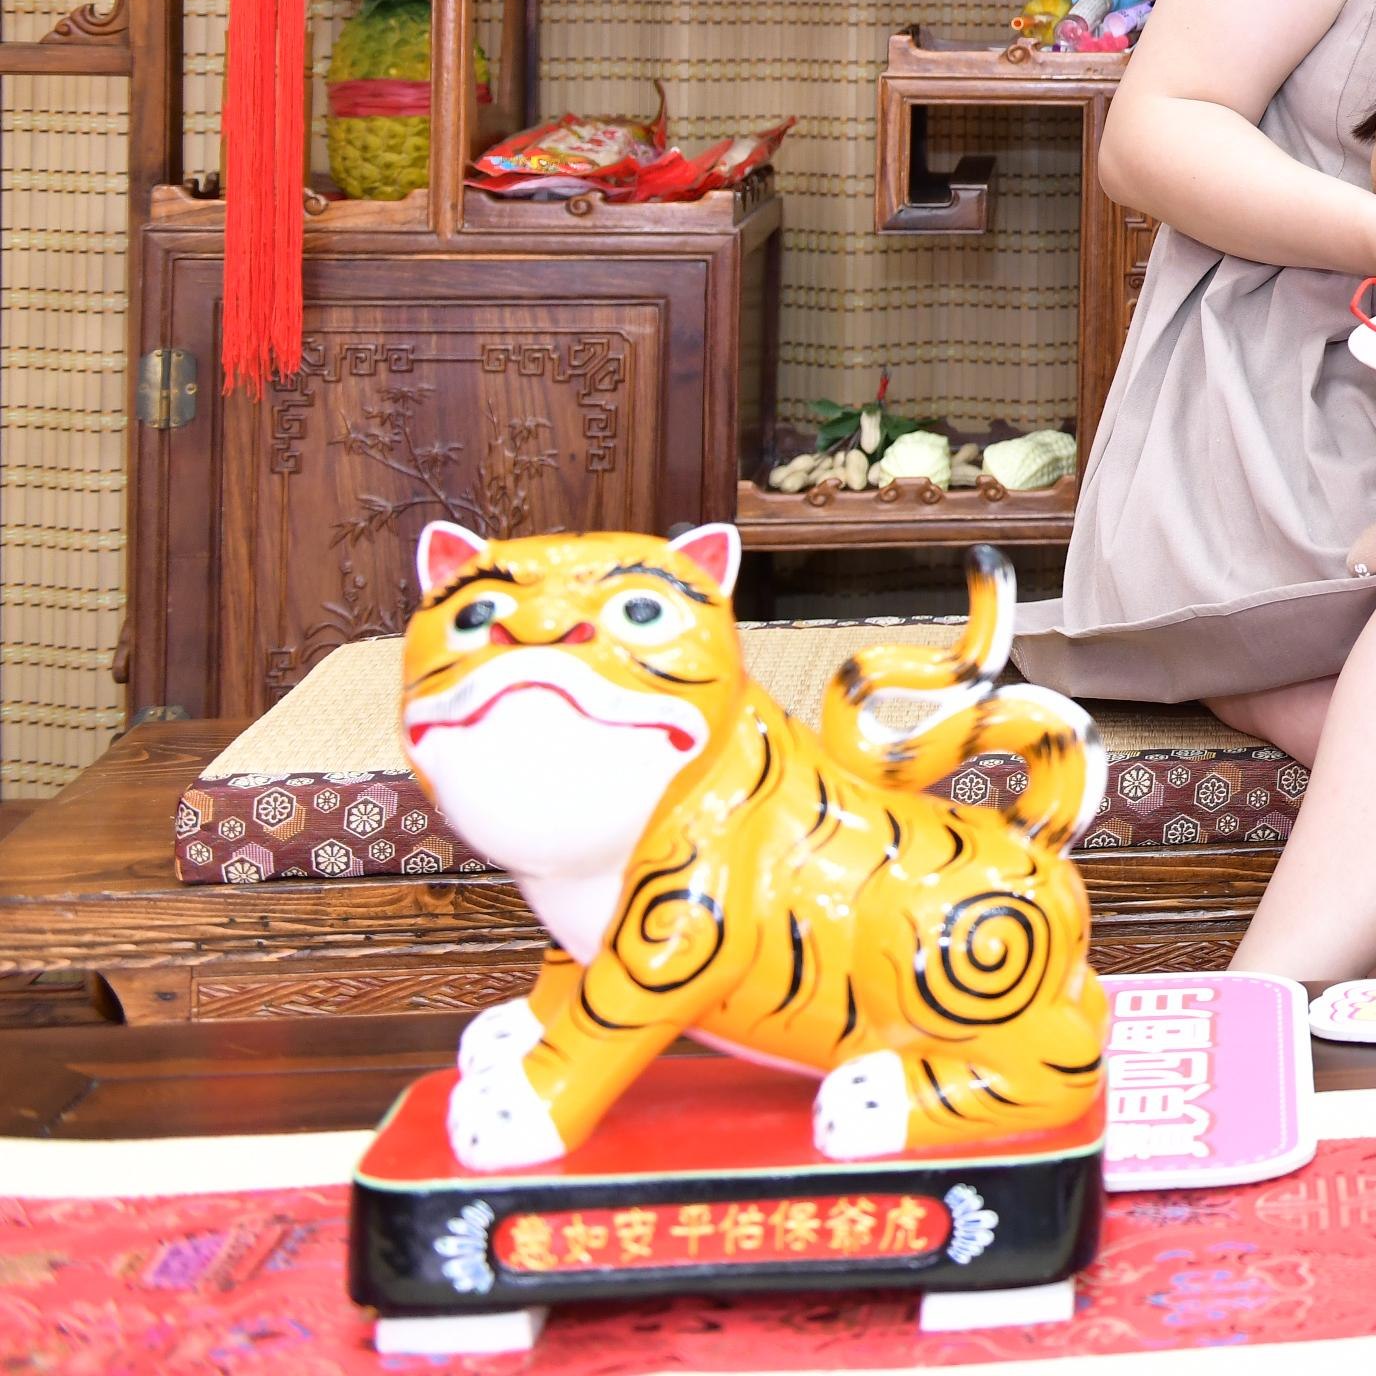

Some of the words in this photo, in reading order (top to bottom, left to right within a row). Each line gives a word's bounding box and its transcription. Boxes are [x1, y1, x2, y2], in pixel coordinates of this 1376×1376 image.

[1106, 986, 1215, 1162] 寶貝四個月
